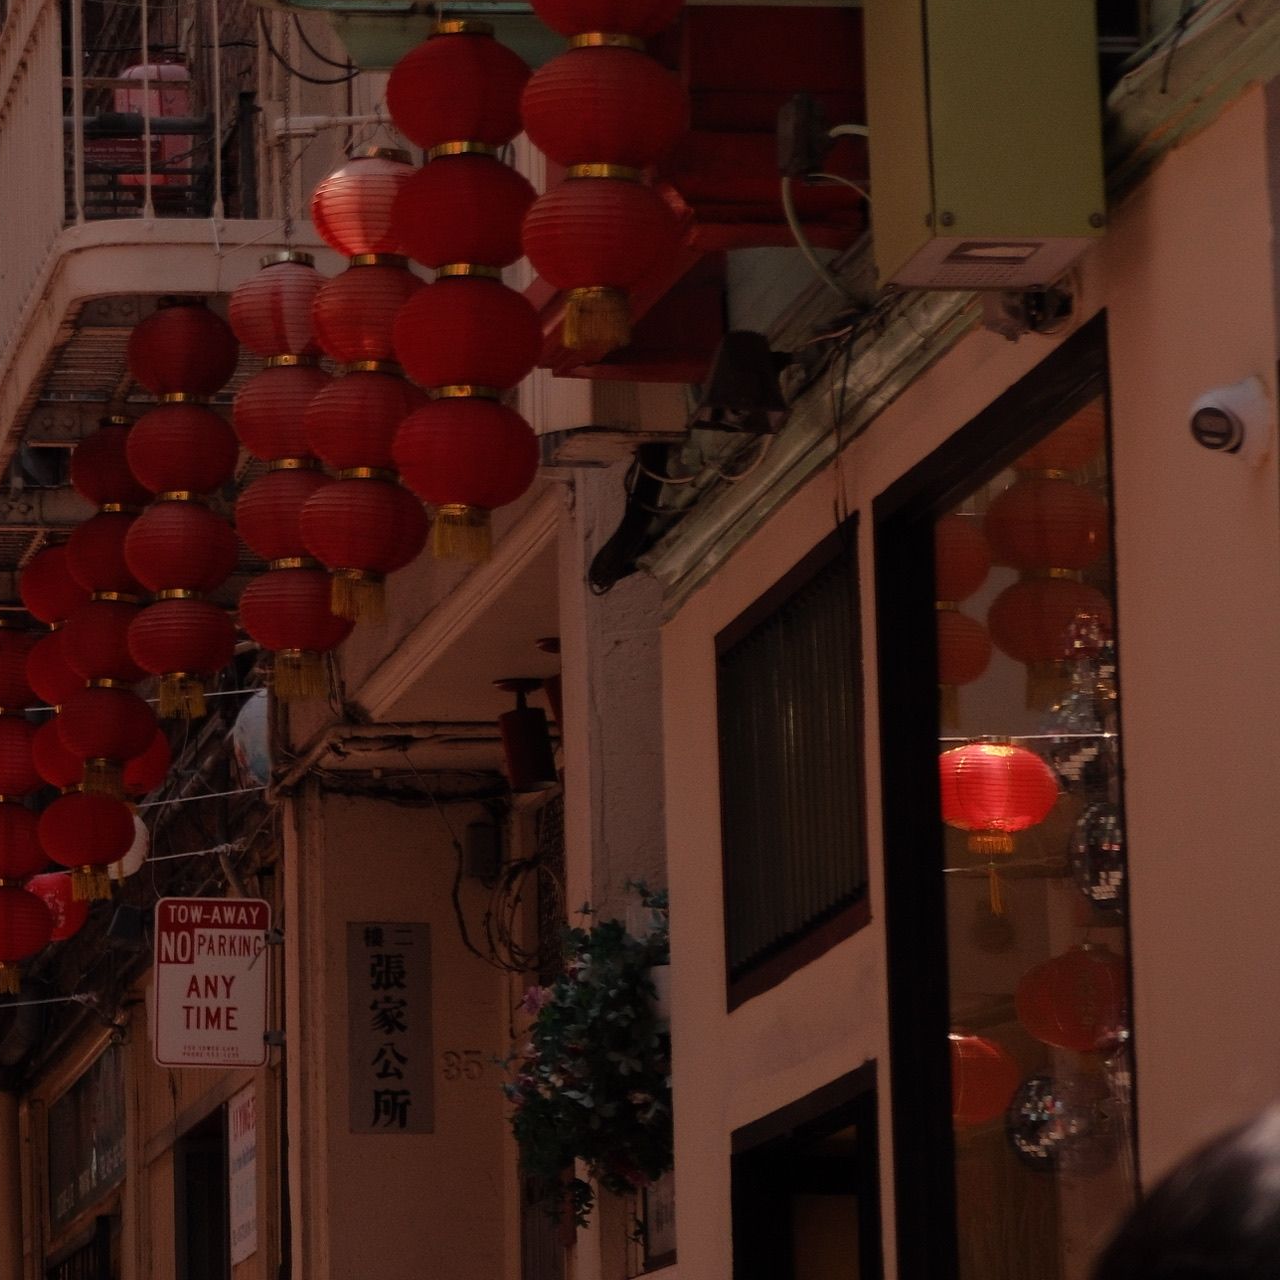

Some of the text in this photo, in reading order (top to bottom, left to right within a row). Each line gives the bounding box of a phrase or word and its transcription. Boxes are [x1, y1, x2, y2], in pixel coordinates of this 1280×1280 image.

[168, 904, 261, 925] TOW-AWAY
[160, 931, 262, 963] NO PARKING
[186, 974, 237, 999] ANY
[182, 1006, 239, 1031] TIME
[369, 952, 412, 1129] 張家公所
